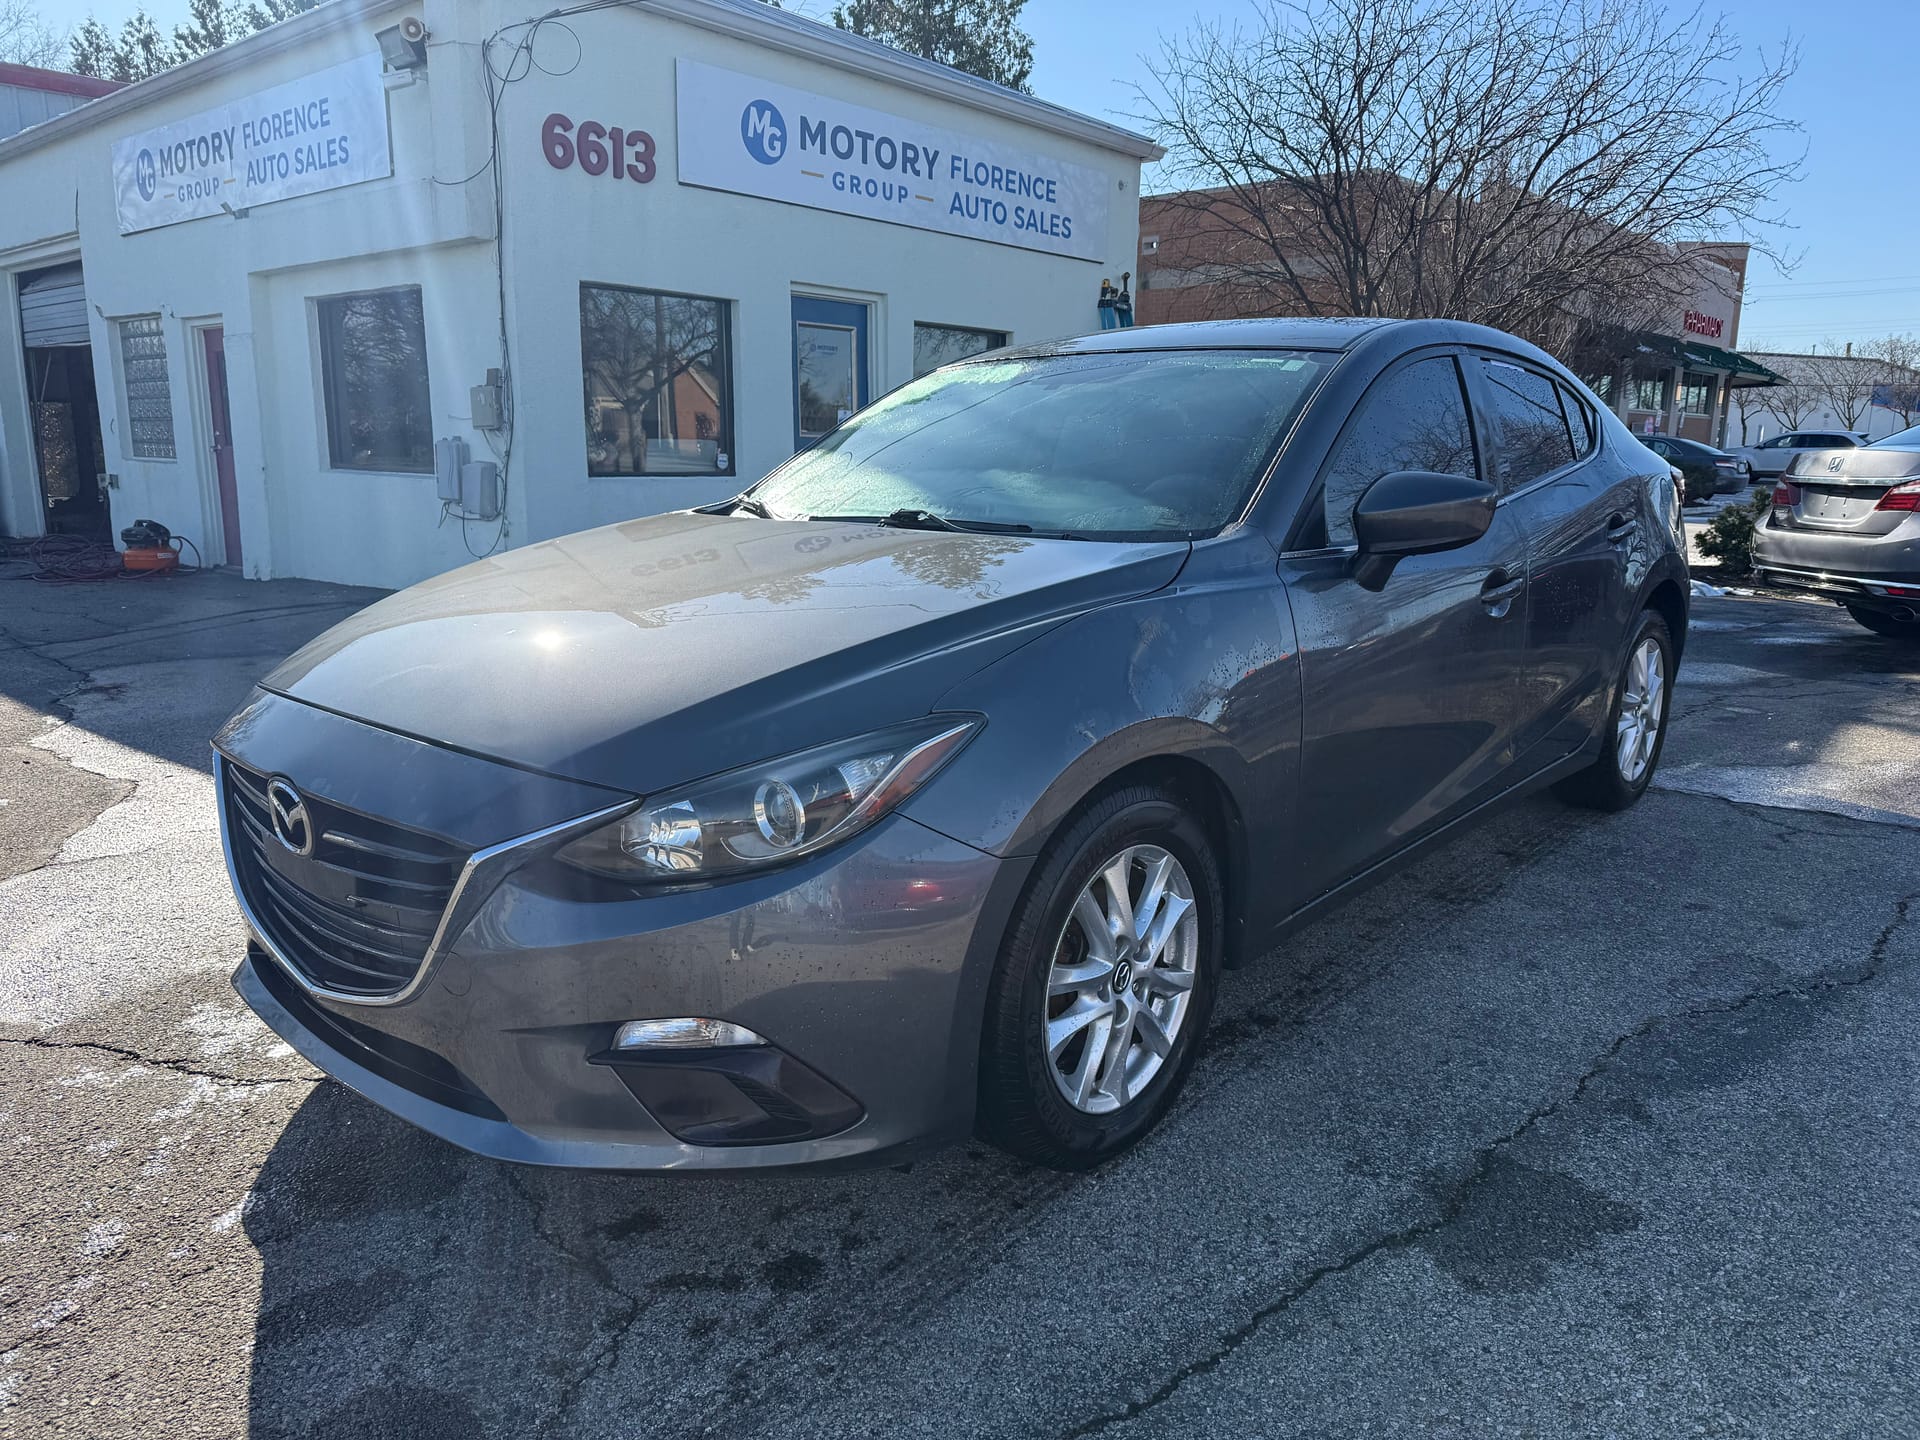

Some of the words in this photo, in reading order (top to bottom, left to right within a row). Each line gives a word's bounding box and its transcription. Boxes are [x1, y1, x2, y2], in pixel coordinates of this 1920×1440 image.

[241, 97, 330, 150] FLORENCE
[541, 113, 657, 184] 6613
[746, 104, 784, 161] MG
[800, 115, 940, 181] MOTORY
[159, 126, 235, 178] MOTORY
[246, 152, 289, 188] AUTO
[294, 135, 350, 175] SALES
[178, 177, 220, 202] GROUP
[832, 171, 909, 204] GROUP
[950, 154, 1057, 204] FLORENCE
[949, 191, 1008, 225] AUTO
[1013, 206, 1072, 239] SALES
[1683, 310, 1724, 338] PHARMACY
